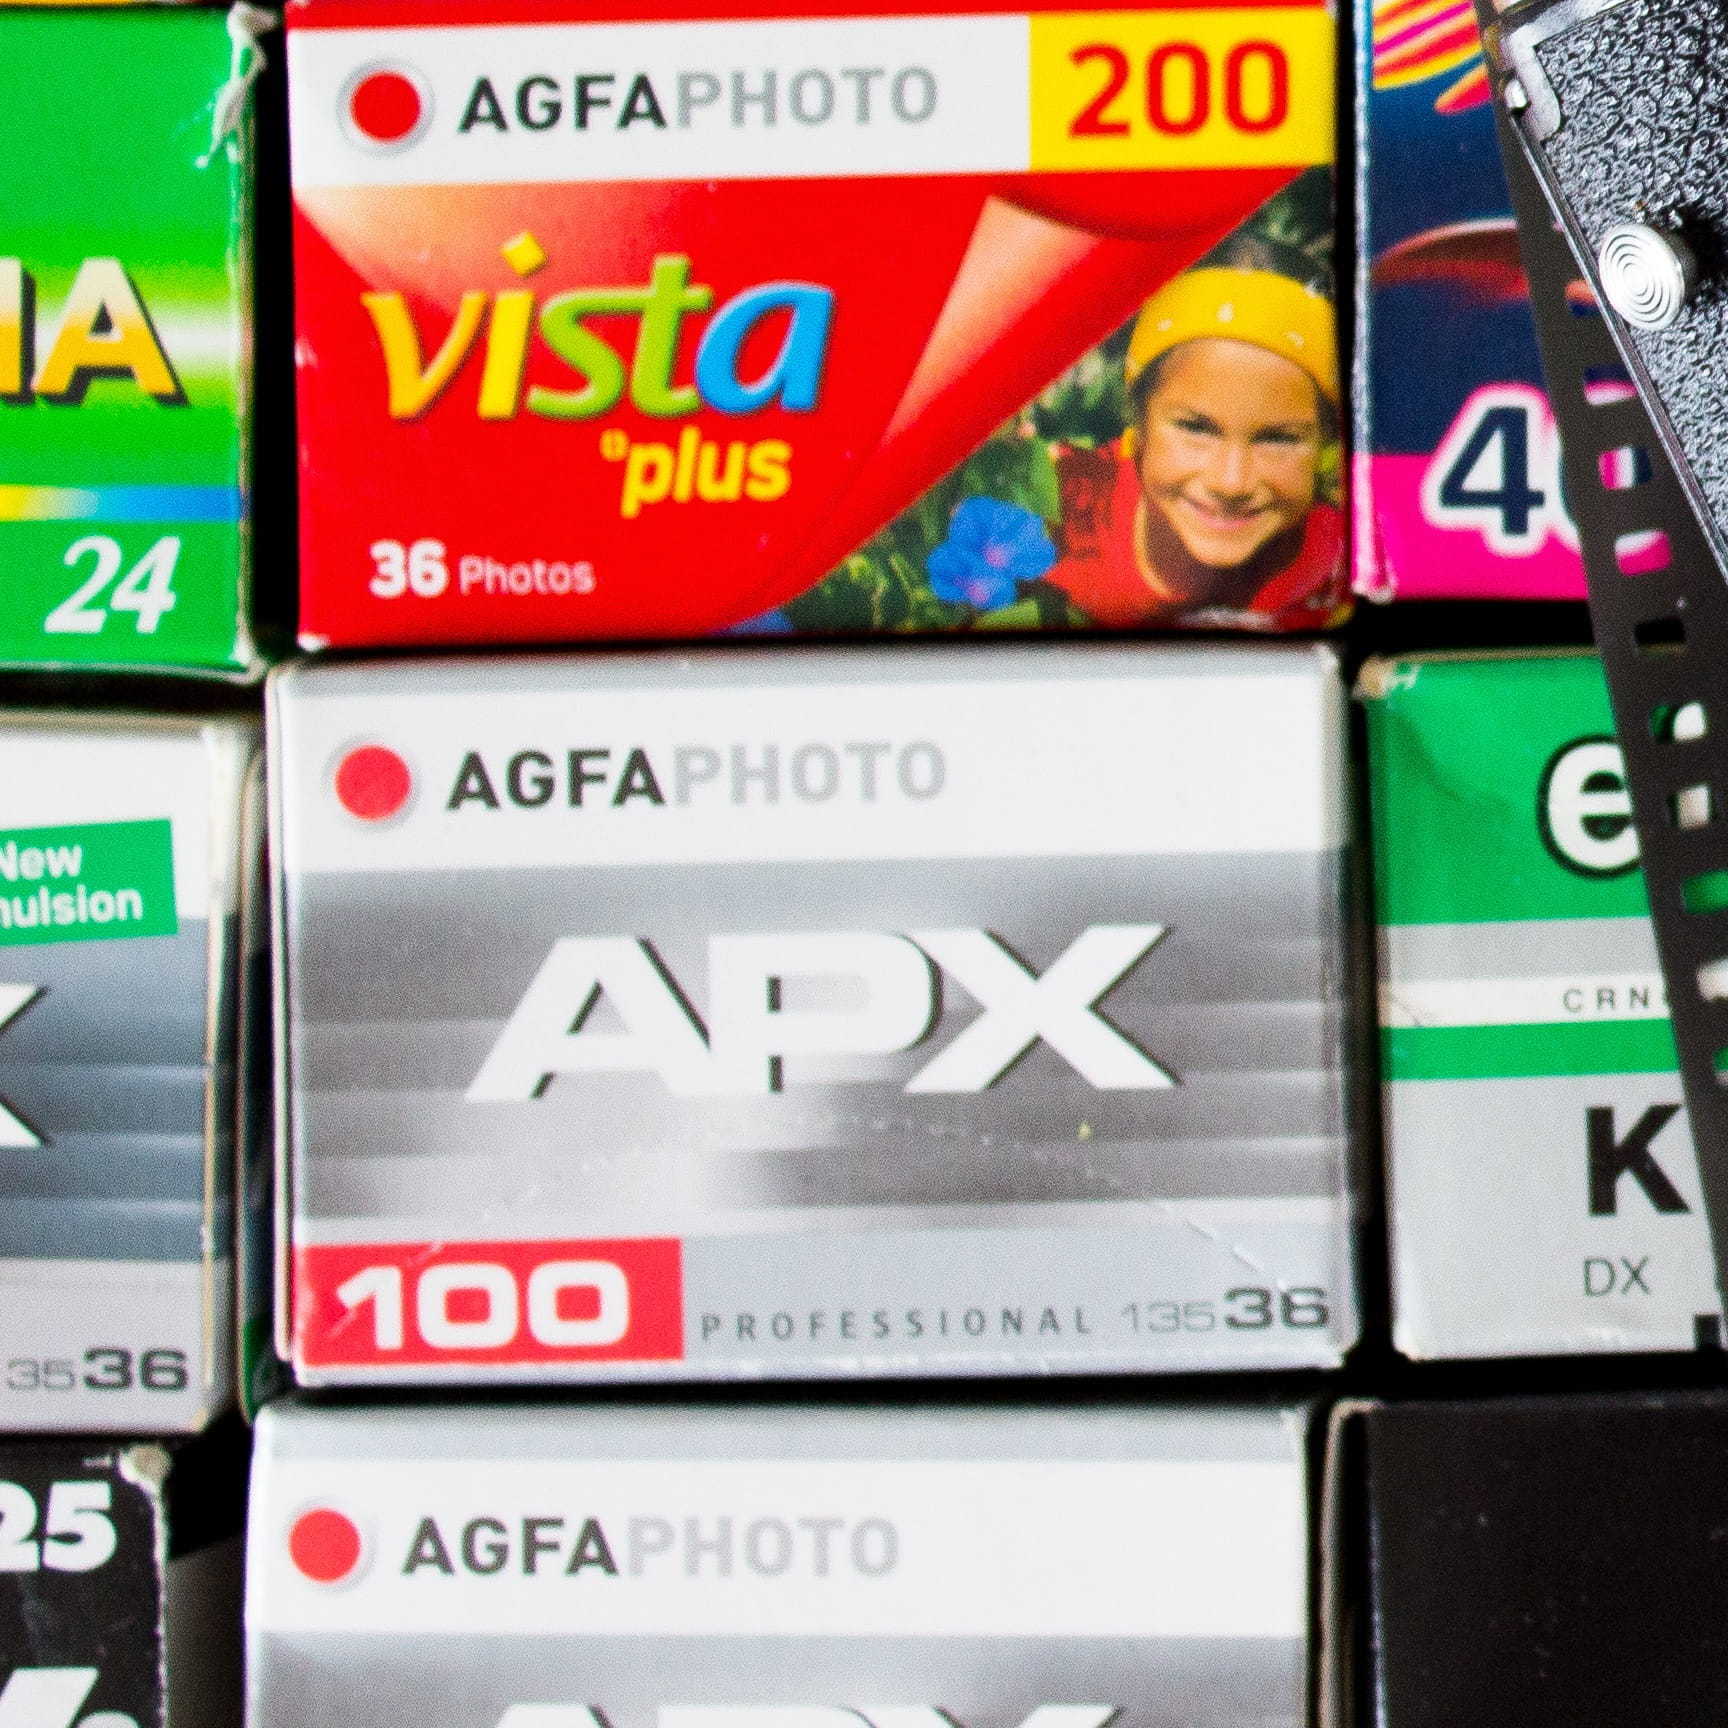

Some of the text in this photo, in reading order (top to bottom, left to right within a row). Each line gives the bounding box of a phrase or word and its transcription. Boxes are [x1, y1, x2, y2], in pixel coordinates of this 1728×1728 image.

[457, 66, 938, 133] AGFAPHOTO
[1066, 38, 1291, 140] 200
[362, 230, 836, 421] vista
[620, 427, 792, 519] plus
[43, 534, 182, 635] 24
[369, 538, 597, 600] 36 Photos
[446, 739, 947, 812] AGFAPHOTO
[465, 922, 1183, 1105] APX
[1562, 987, 1670, 1015] CRN
[336, 1258, 630, 1353] 100
[700, 1306, 1093, 1342] PROFESSIONAL
[1583, 1255, 1652, 1298] DX
[400, 1514, 900, 1579] AGFAPHOTO
